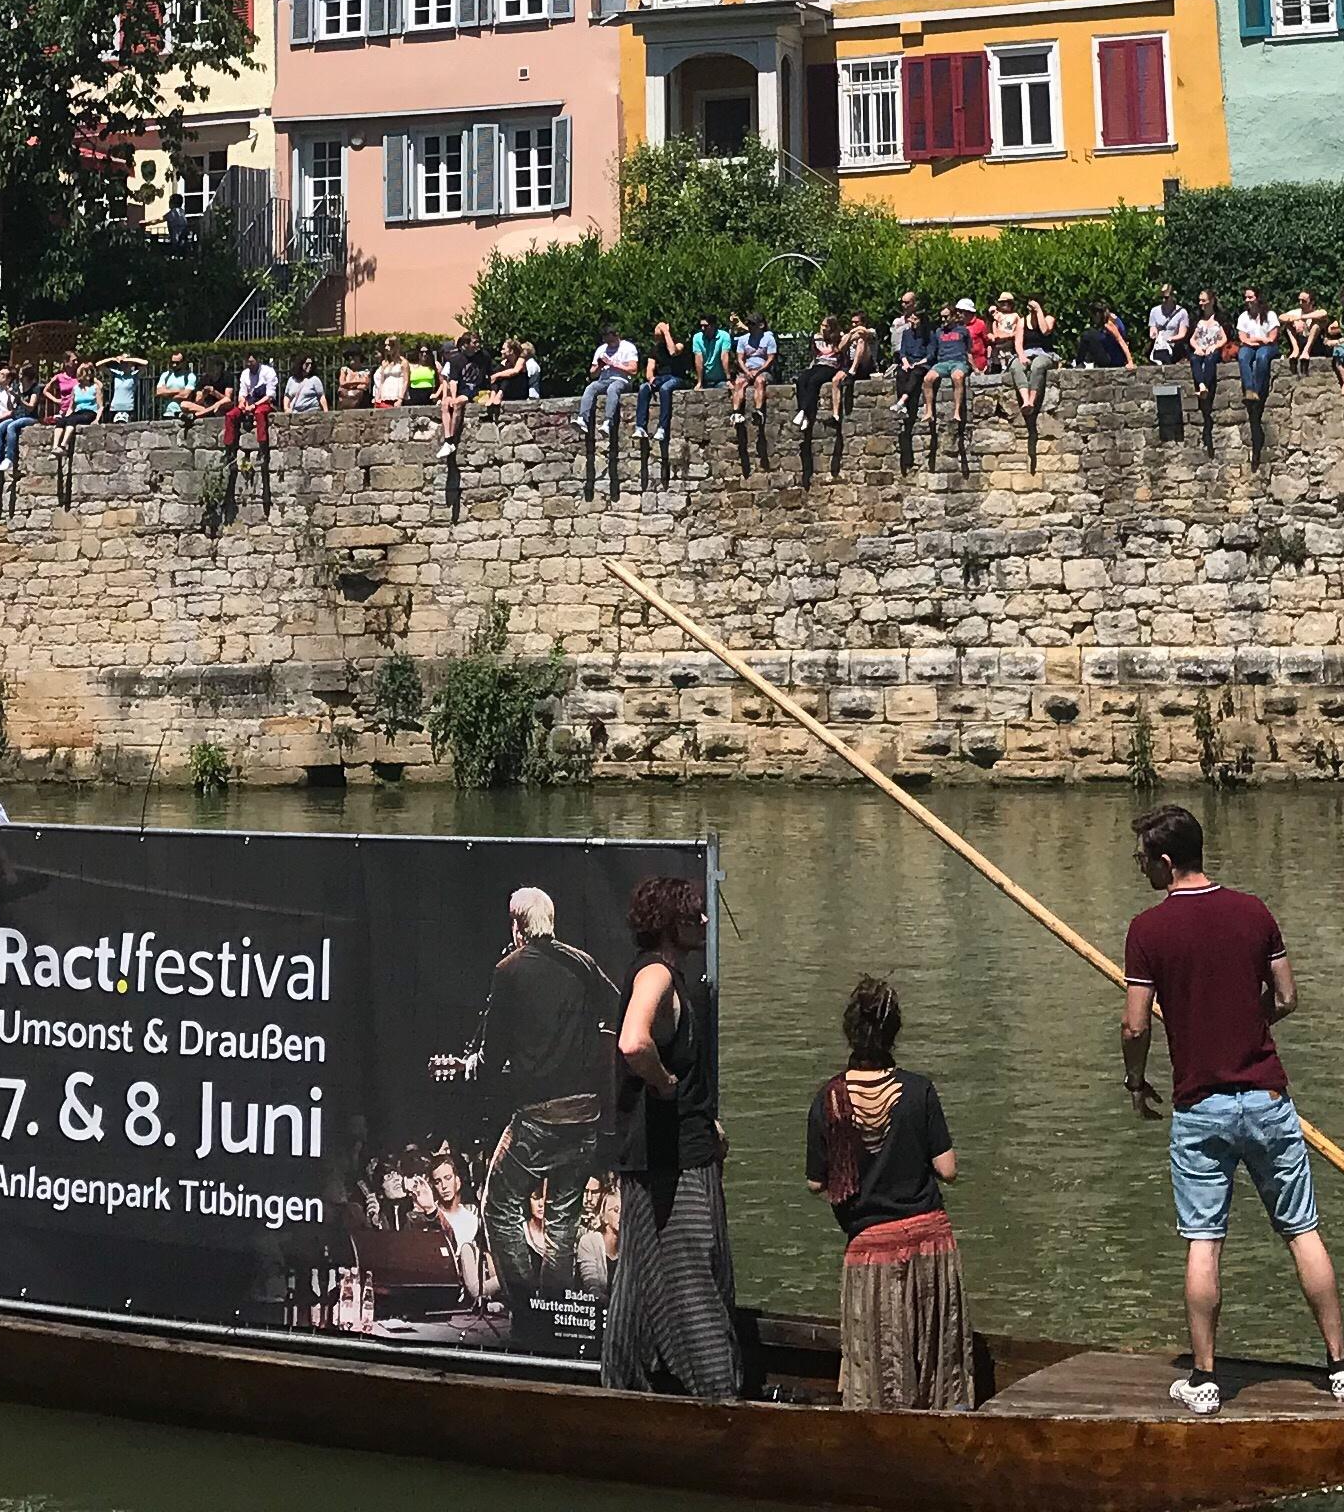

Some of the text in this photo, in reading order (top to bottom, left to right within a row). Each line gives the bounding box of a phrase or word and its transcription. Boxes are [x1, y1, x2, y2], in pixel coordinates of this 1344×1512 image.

[143, 1017, 169, 1054] &
[179, 1020, 326, 1063] Draußen
[58, 1071, 105, 1142] &
[124, 1081, 176, 1147] 8.
[195, 1081, 323, 1159] Juni
[178, 1179, 324, 1230] Tübingen
[529, 1298, 596, 1318] Württemberg
[564, 1289, 599, 1302] Baden-
[554, 1313, 596, 1331] Stiftung
